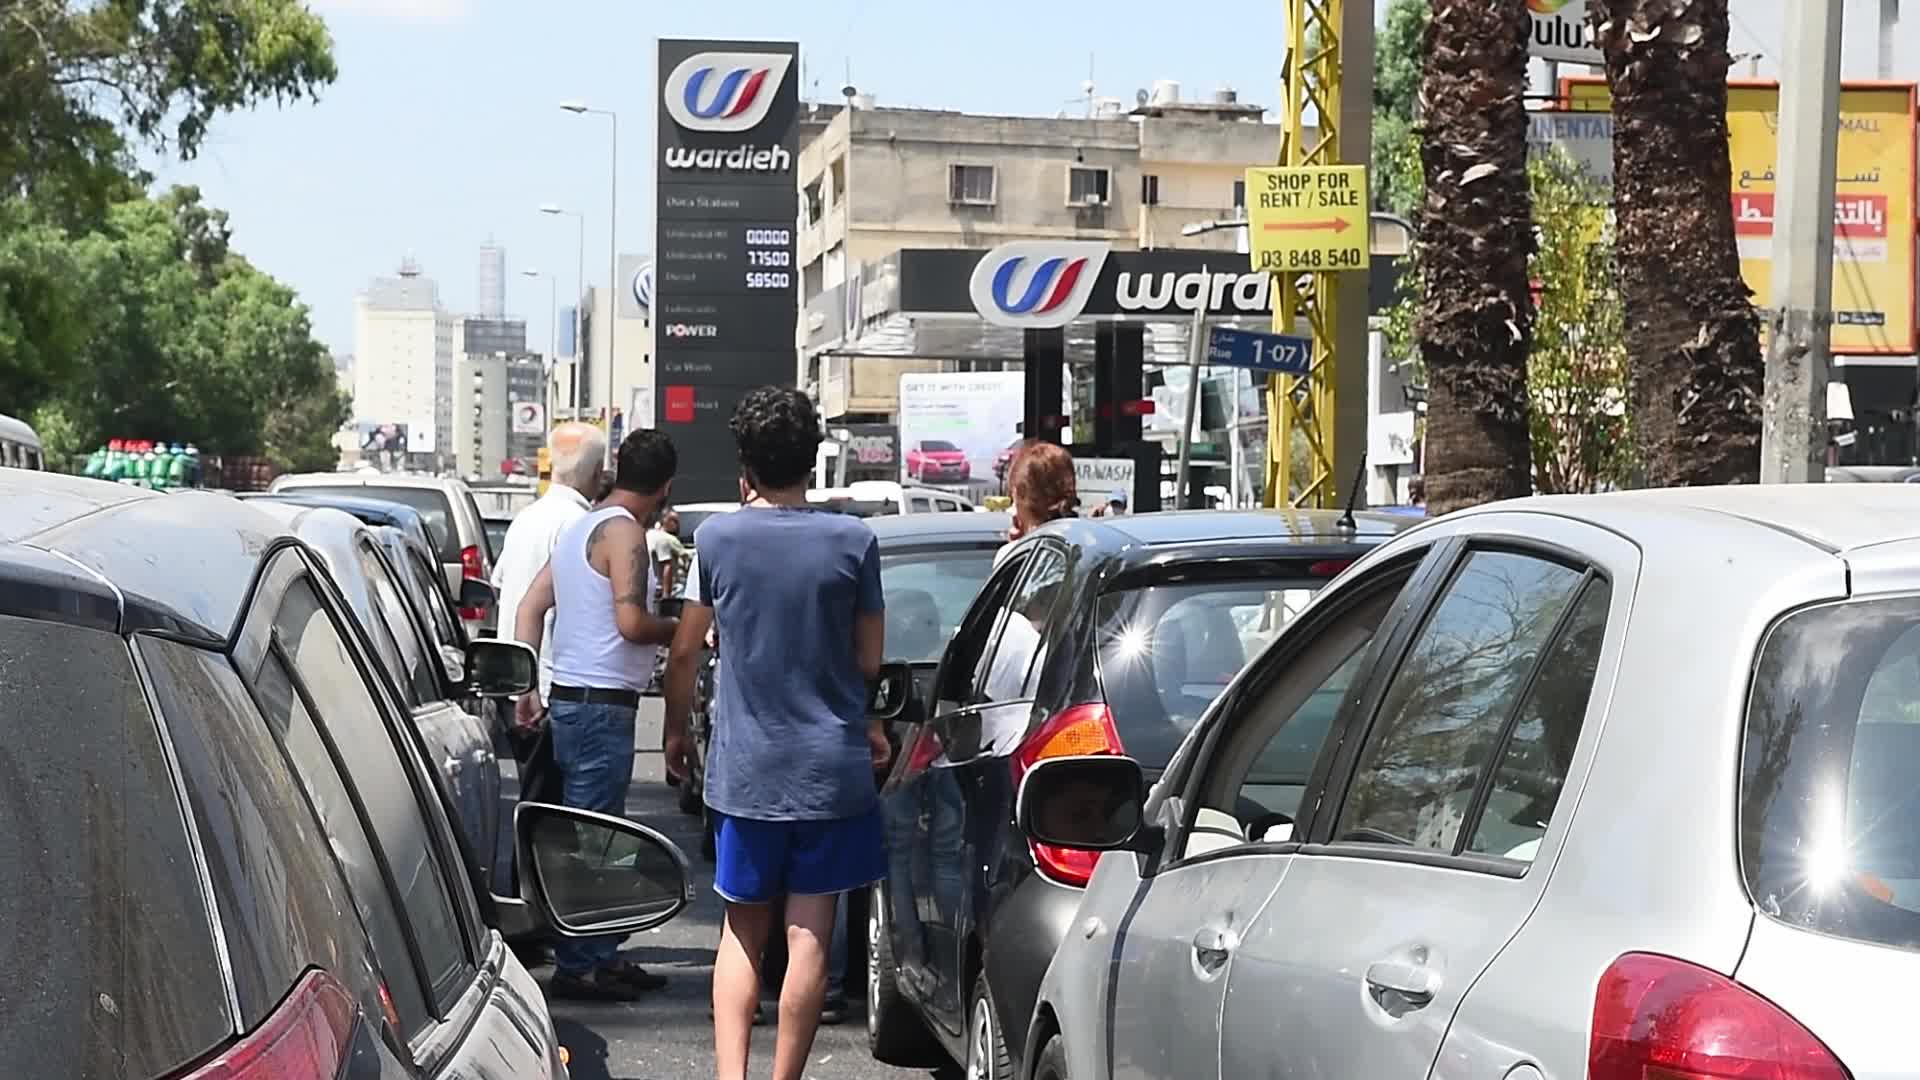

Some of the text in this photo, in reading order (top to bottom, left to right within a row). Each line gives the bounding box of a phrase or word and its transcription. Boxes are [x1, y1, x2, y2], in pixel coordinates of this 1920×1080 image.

[1528, 13, 1600, 49] ulu
[665, 145, 790, 170] wardieh
[1267, 173, 1349, 190] SHOP FOR
[1260, 192, 1302, 208] RENT
[1319, 191, 1359, 206] SALE
[746, 230, 791, 245] 00000
[747, 251, 791, 266] 77500
[1262, 248, 1361, 267] 03 848 540
[746, 272, 791, 288] 58500
[665, 323, 718, 337] POWER
[1209, 339, 1297, 364] Rue 1-07
[1076, 464, 1133, 481] AR WASH
